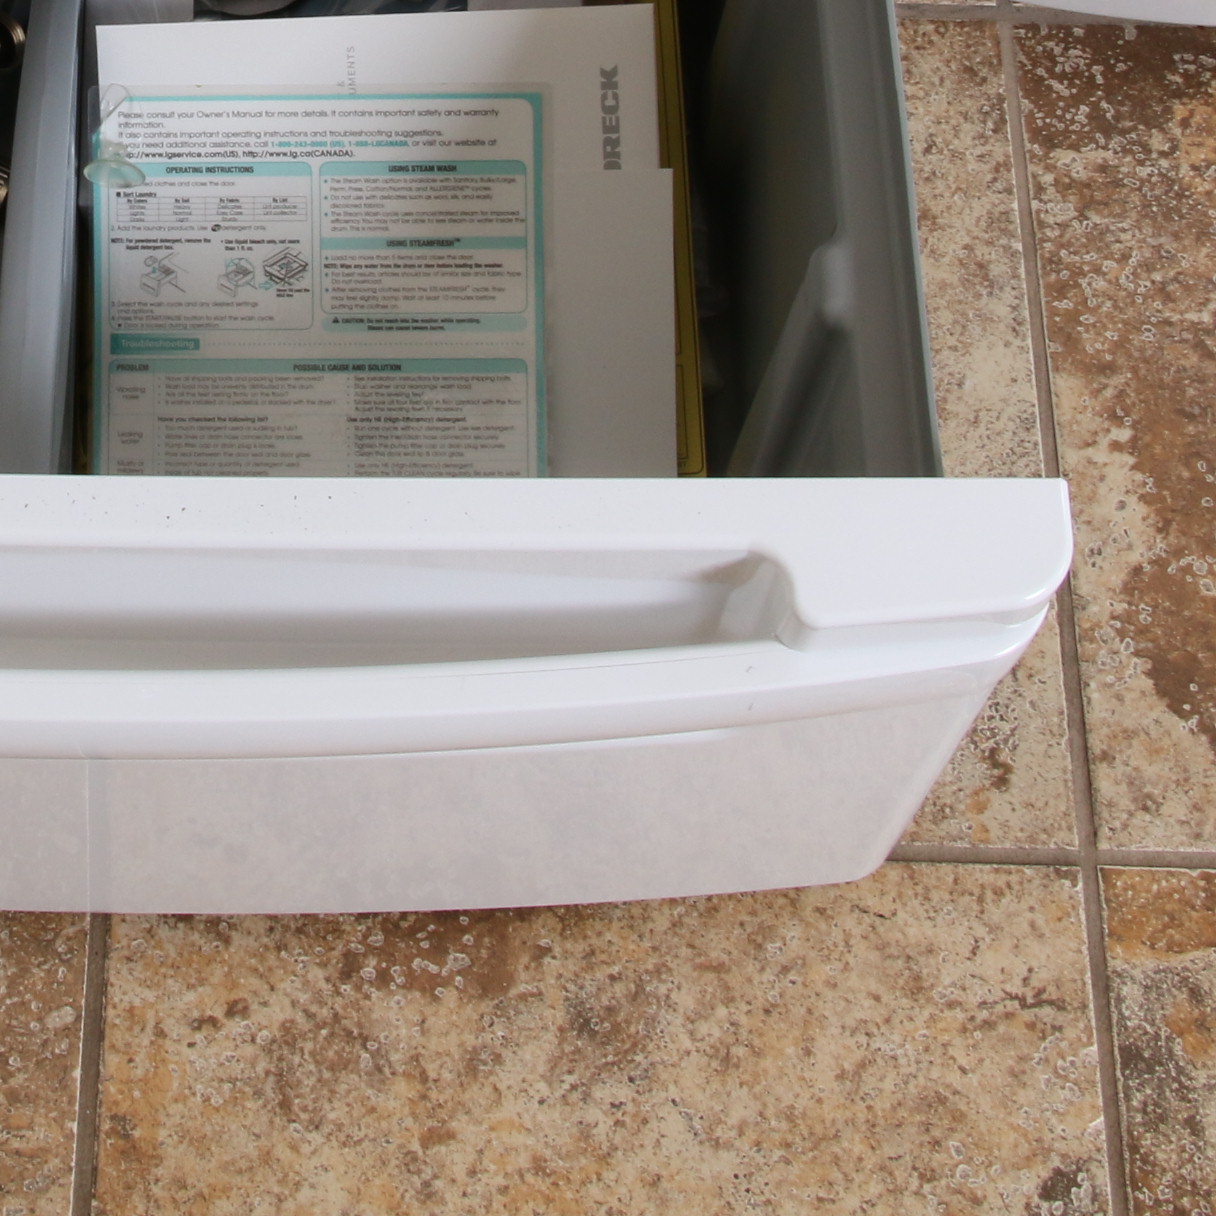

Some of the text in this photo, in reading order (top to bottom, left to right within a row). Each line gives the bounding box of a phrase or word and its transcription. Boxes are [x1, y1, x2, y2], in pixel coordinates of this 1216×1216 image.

[177, 111, 194, 119] your
[338, 109, 373, 117] contains
[374, 109, 415, 118] important
[417, 109, 441, 118] safety
[463, 109, 498, 118] warranty
[119, 121, 165, 129] information.
[125, 130, 140, 138] also
[179, 130, 219, 139] important
[221, 130, 261, 139] operating
[328, 130, 392, 138] troubleshooting
[394, 129, 443, 138] suggestions.
[121, 339, 194, 349] Troubleshooting
